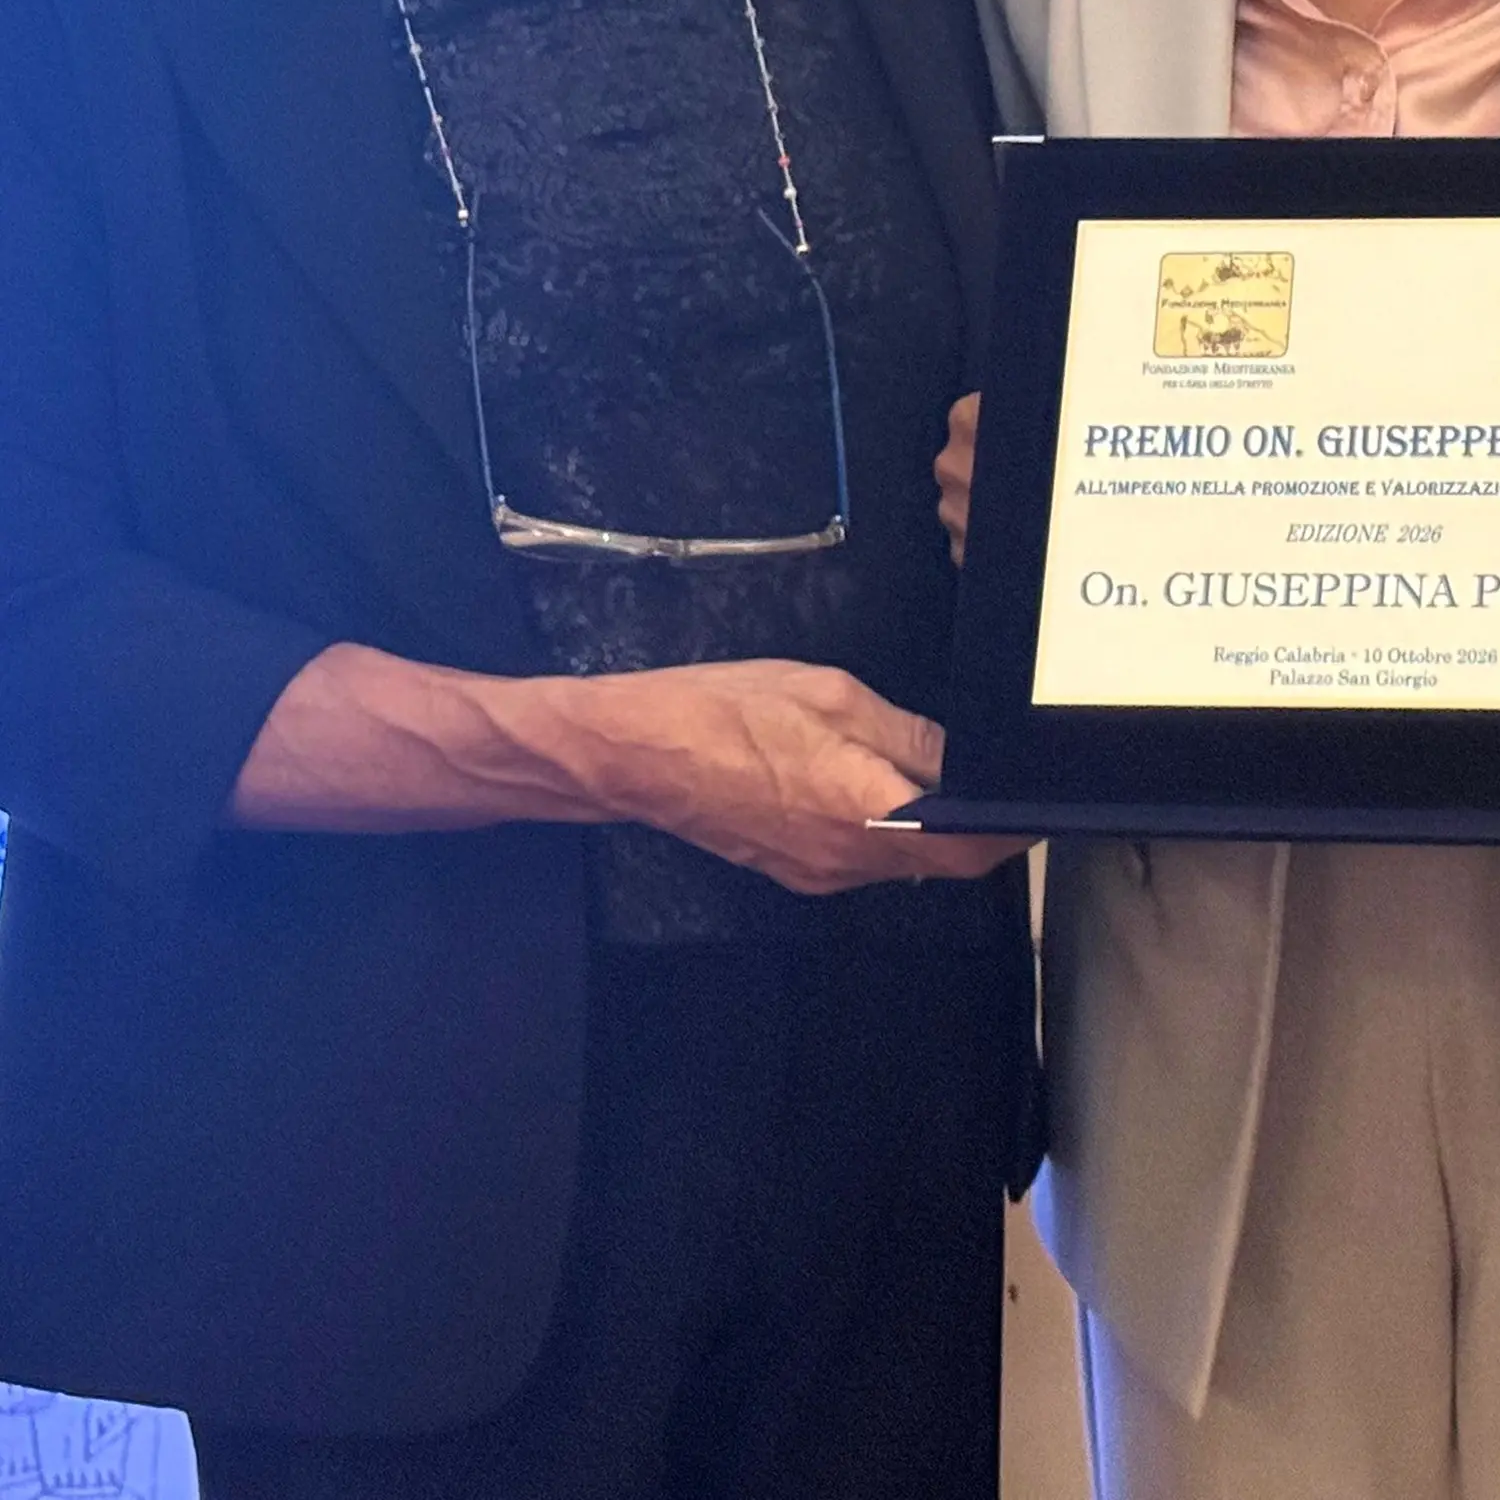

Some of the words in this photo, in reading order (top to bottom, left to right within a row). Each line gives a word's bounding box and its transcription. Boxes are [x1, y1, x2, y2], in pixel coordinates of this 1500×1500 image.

[1084, 425, 1232, 459] PREMIO
[1243, 425, 1304, 458] ON.
[1074, 480, 1186, 497] ALL'IMPEGNO
[1191, 480, 1246, 496] NELLA
[1252, 480, 1360, 497] PROMOZIONE
[1365, 480, 1376, 497] E
[1285, 523, 1388, 544] EDIZIONE
[1397, 524, 1443, 544] 2026
[1080, 571, 1148, 607] On.
[1163, 571, 1458, 608] GIUSEPPINA
[1213, 646, 1269, 666] Reggio
[1274, 646, 1346, 663] Calabria
[1364, 648, 1382, 664] 10
[1387, 648, 1451, 664] Ottobre
[1457, 649, 1498, 665] 2026
[1270, 669, 1333, 686] Palazzo
[1338, 669, 1370, 686] San
[1376, 670, 1437, 690] Giorgio
